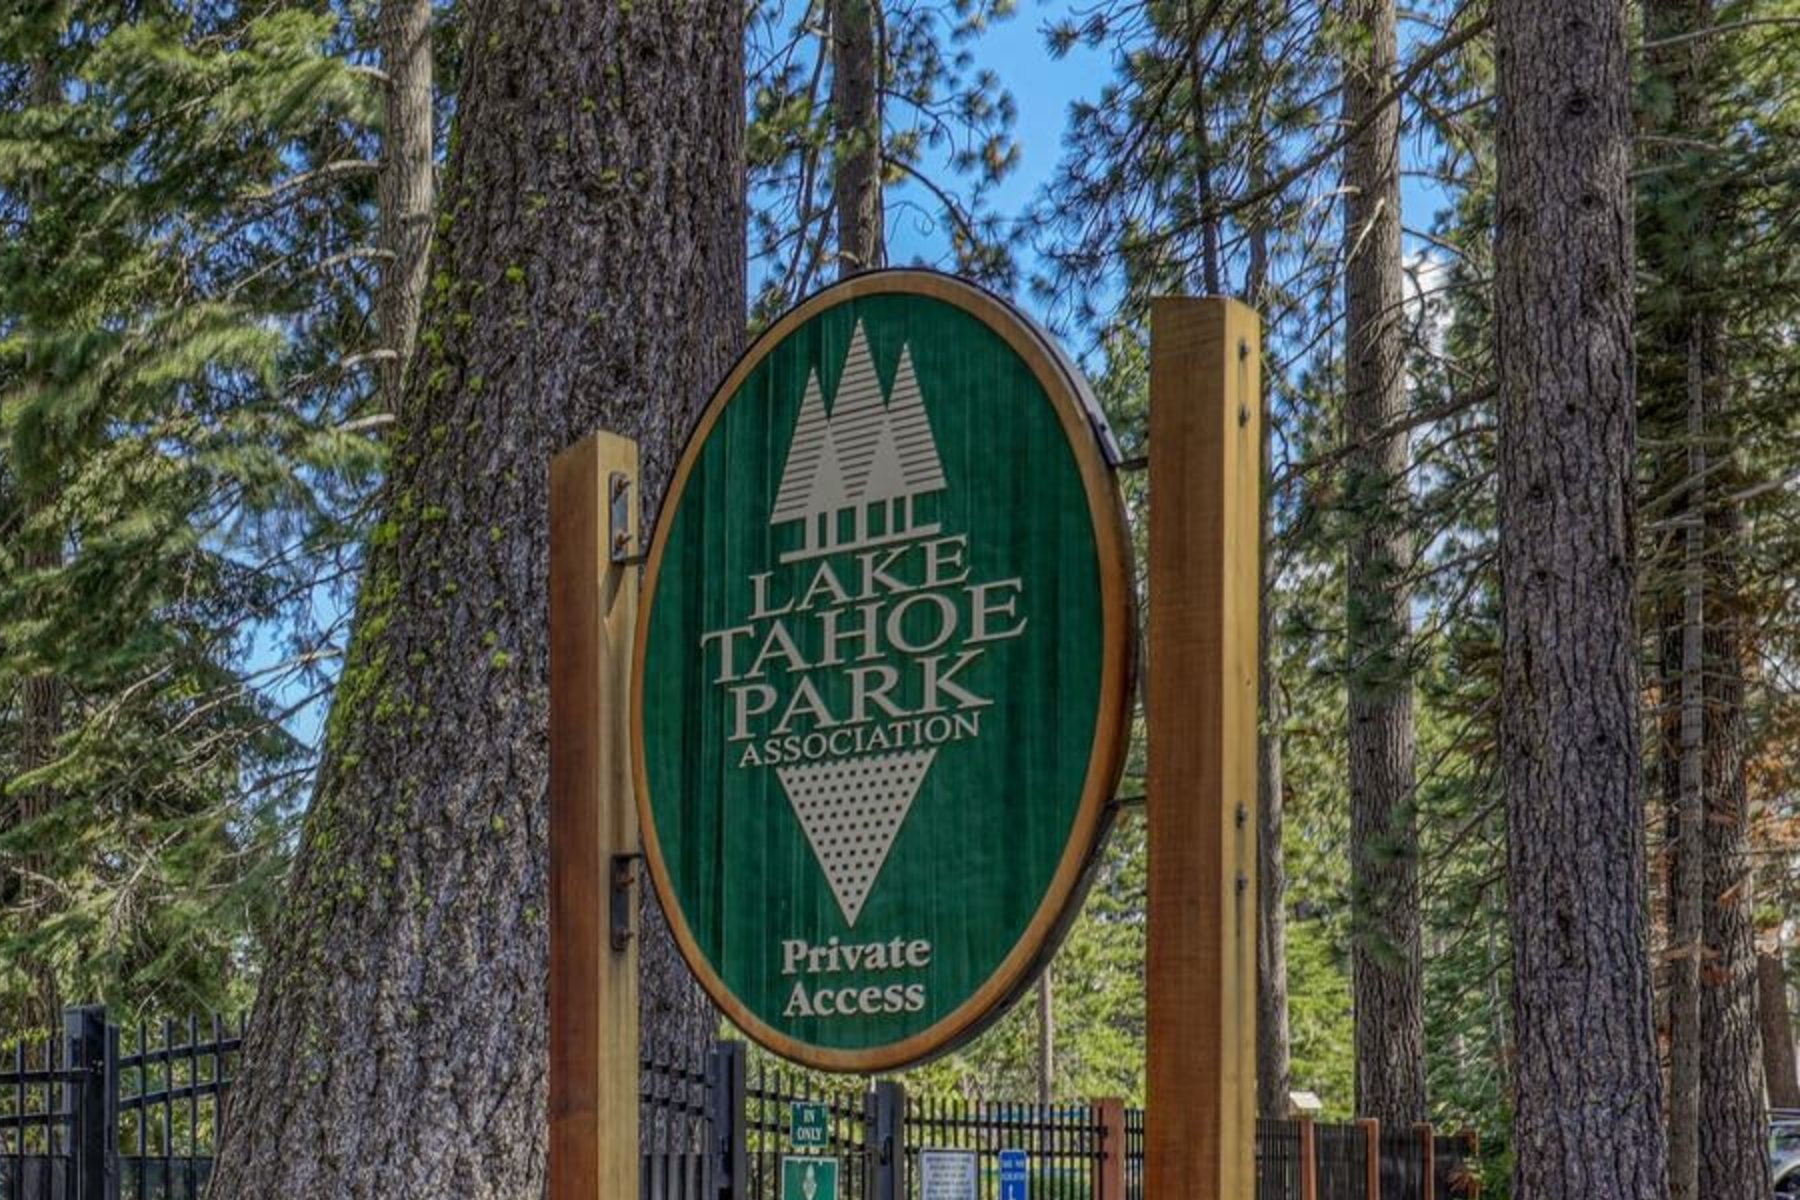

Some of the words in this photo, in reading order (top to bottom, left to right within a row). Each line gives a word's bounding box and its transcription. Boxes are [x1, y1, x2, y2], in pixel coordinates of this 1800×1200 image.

[747, 534, 970, 620] LAKE
[700, 577, 1028, 686] TAHOE
[727, 648, 995, 742] PARK
[738, 711, 981, 768] ASSOCIATION
[781, 936, 932, 976] Private
[782, 981, 926, 1018] Access
[797, 1126, 823, 1140] ONLY
[803, 1109, 815, 1122] IN
